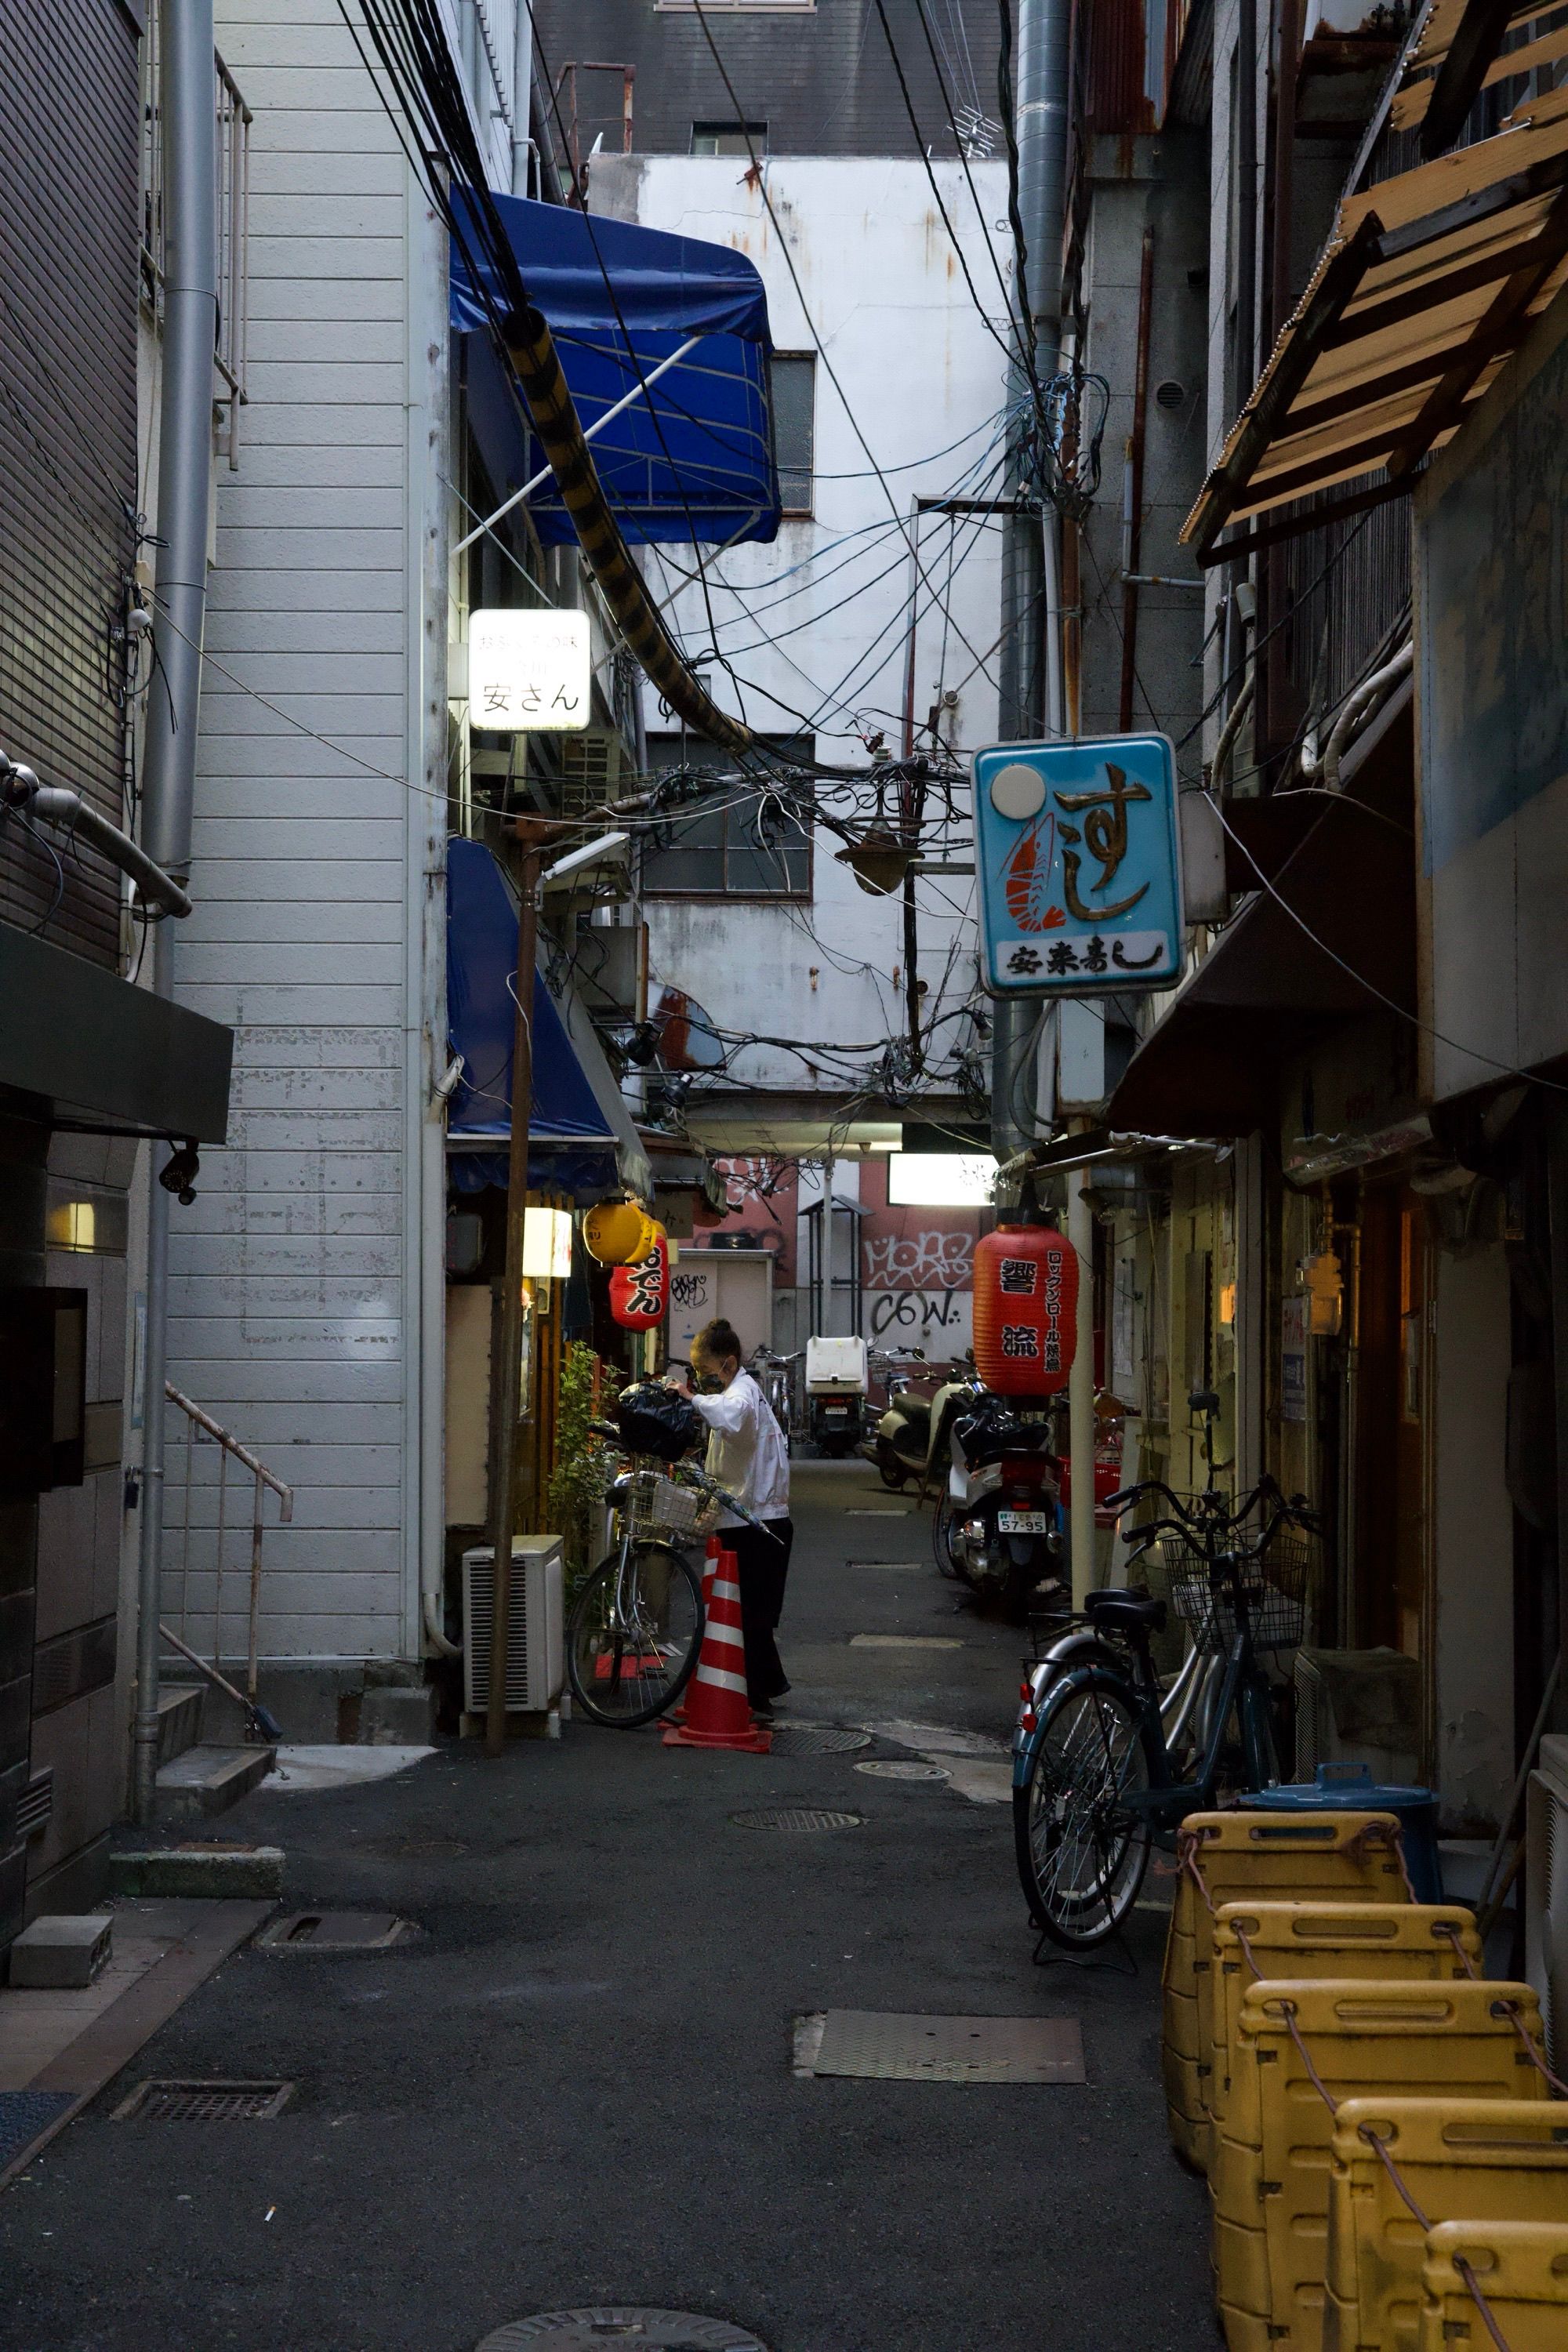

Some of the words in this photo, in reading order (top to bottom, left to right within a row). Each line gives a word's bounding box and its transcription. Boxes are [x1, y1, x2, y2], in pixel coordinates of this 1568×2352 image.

[483, 682, 579, 713] 安さん
[1053, 761, 1152, 922] すし
[1007, 935, 1163, 977] 安来寿し
[1045, 1251, 1062, 1372] ロックンロール焼鳥
[1001, 1521, 1044, 1532] 57-95
